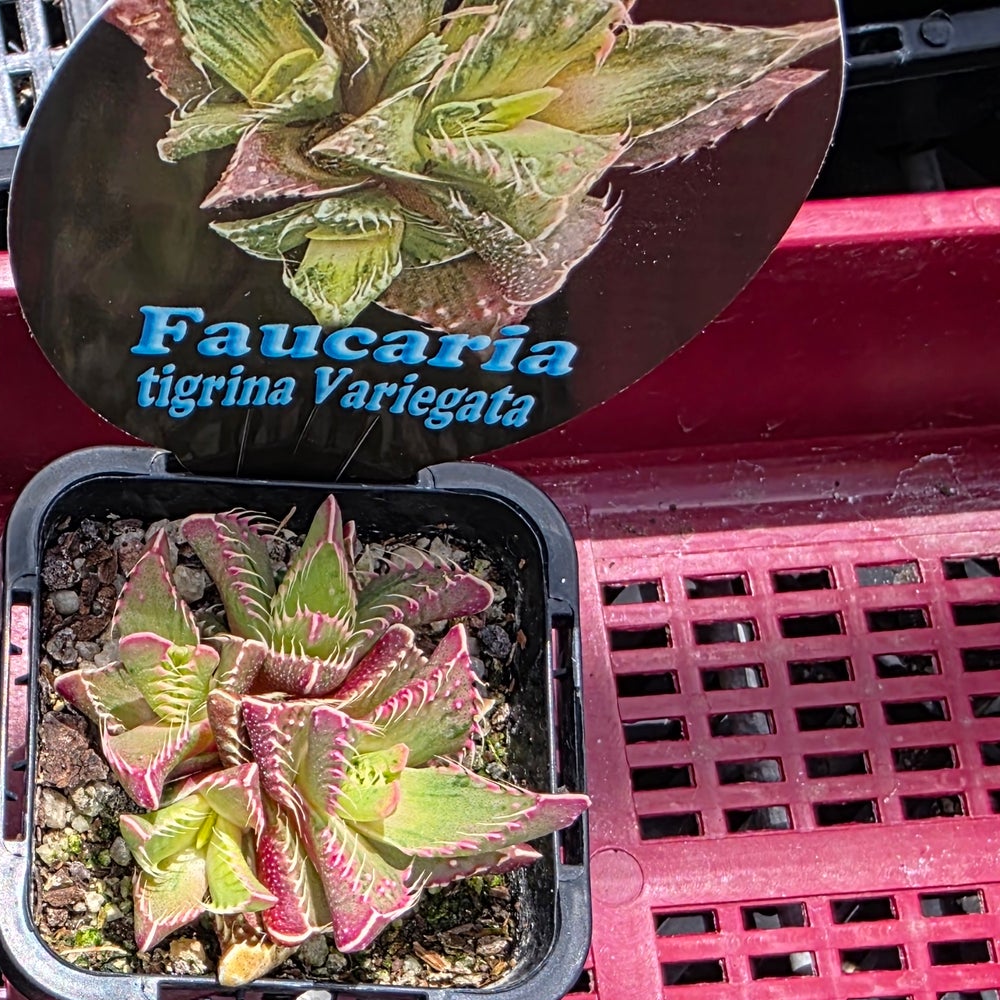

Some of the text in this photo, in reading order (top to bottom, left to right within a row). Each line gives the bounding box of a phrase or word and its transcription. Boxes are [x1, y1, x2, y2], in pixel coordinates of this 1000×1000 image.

[130, 306, 578, 376] Faucaria
[137, 365, 535, 430] tigrina Variegata
